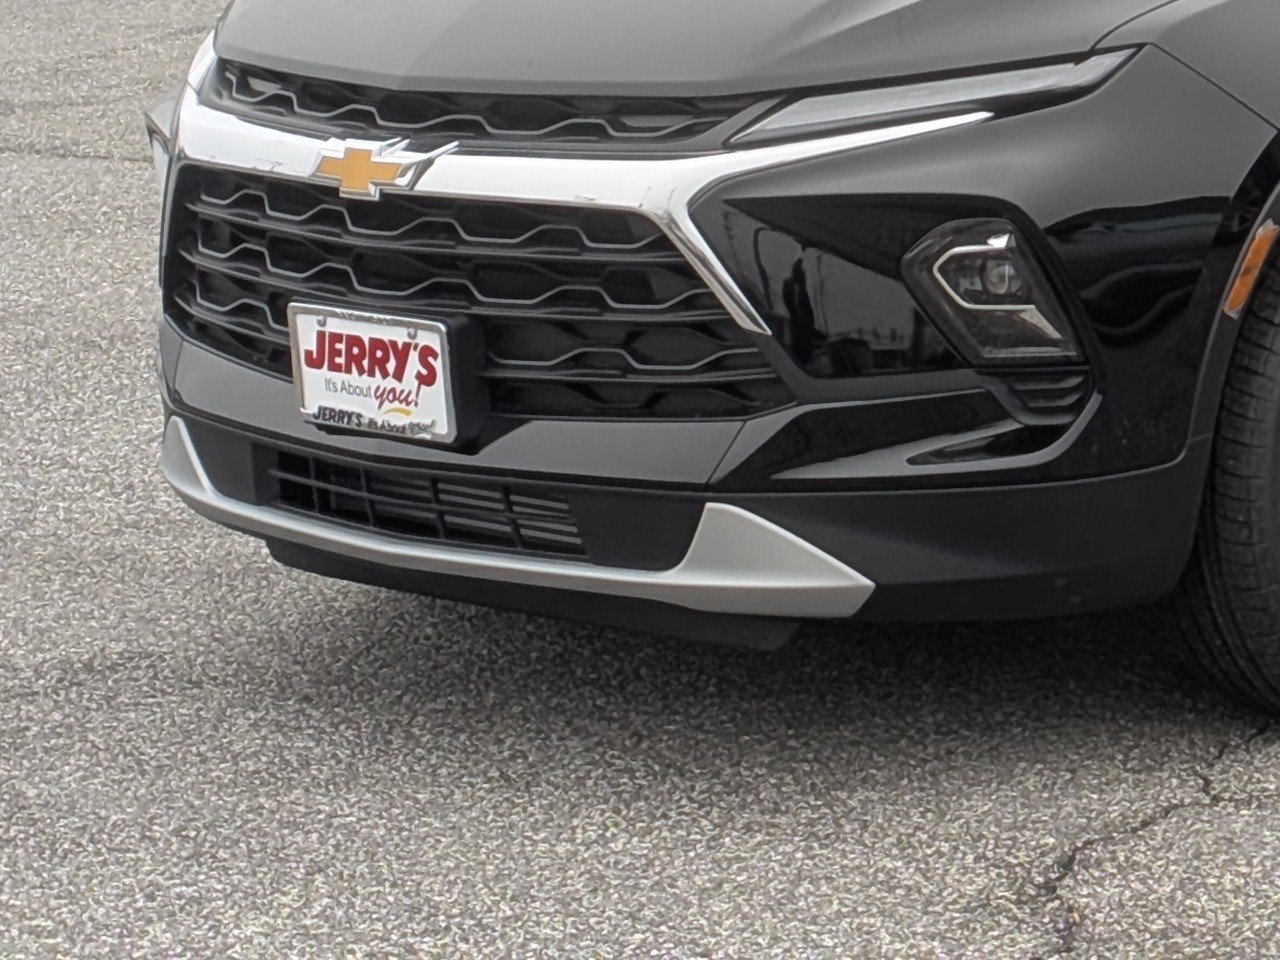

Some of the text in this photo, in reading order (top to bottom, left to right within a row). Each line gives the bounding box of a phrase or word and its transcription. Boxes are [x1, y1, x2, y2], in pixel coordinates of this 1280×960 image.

[304, 330, 439, 387] JERRY'S
[324, 377, 422, 410] It's About you!
[312, 405, 363, 428] JERRY'S
